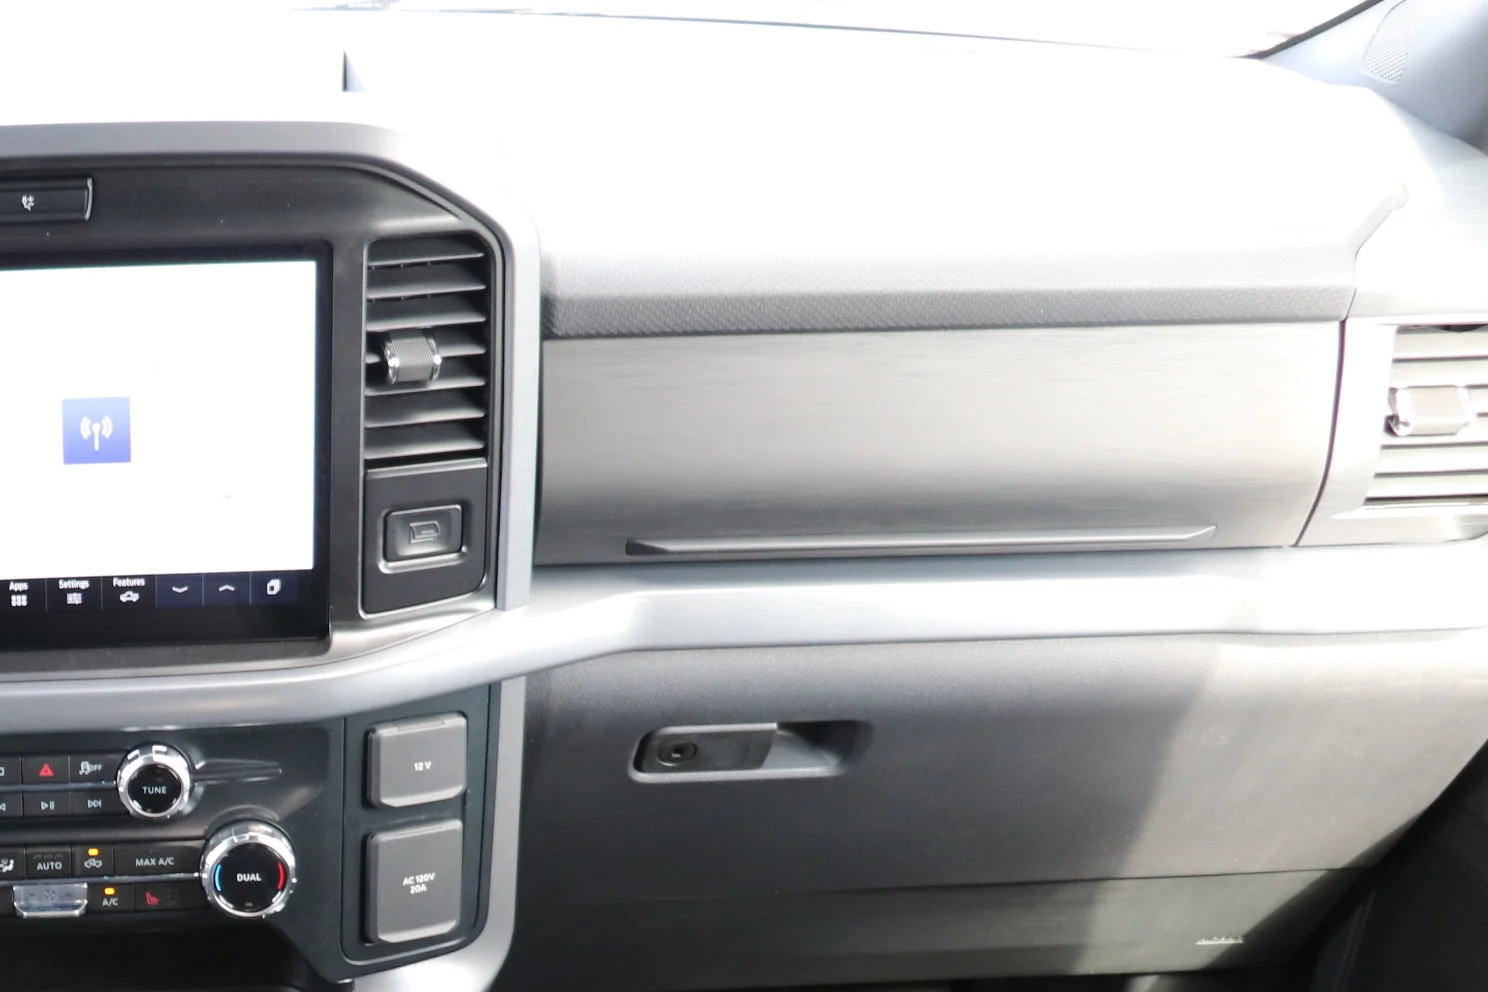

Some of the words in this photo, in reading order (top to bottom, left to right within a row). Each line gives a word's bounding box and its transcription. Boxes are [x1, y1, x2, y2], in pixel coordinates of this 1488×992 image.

[9, 581, 29, 592] Apps
[58, 579, 90, 590] Settings
[112, 577, 146, 588] Features
[414, 762, 424, 771] 12
[424, 761, 432, 770] V
[142, 785, 167, 795] TUNE
[37, 861, 62, 871] AUTO
[135, 858, 156, 867] MAX
[158, 856, 175, 867] A/C
[236, 872, 261, 882] DUAL
[402, 876, 414, 886] AC
[415, 871, 435, 883] 120V
[410, 884, 427, 894] 20A
[102, 897, 118, 907] A/C
